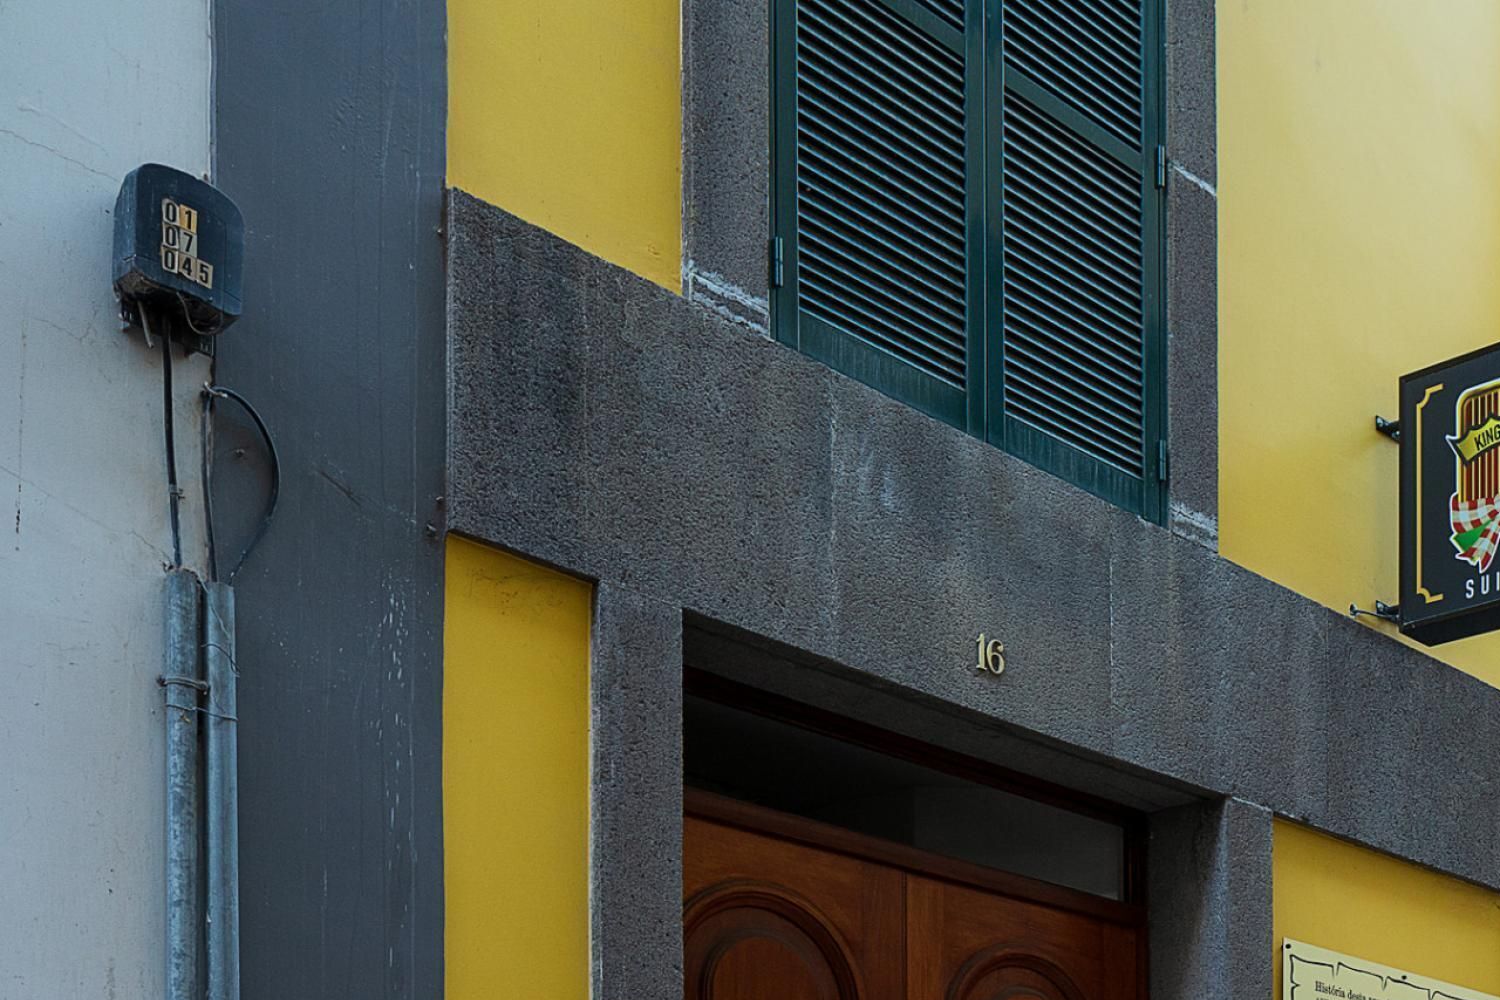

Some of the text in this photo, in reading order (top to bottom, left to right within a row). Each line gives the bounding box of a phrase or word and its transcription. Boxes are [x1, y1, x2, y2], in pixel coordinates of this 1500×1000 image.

[165, 202, 192, 229] 01
[165, 226, 193, 252] 07
[164, 250, 208, 284] 045
[1474, 426, 1500, 451] KING
[976, 633, 1005, 674] 16
[1314, 980, 1345, 998] História
